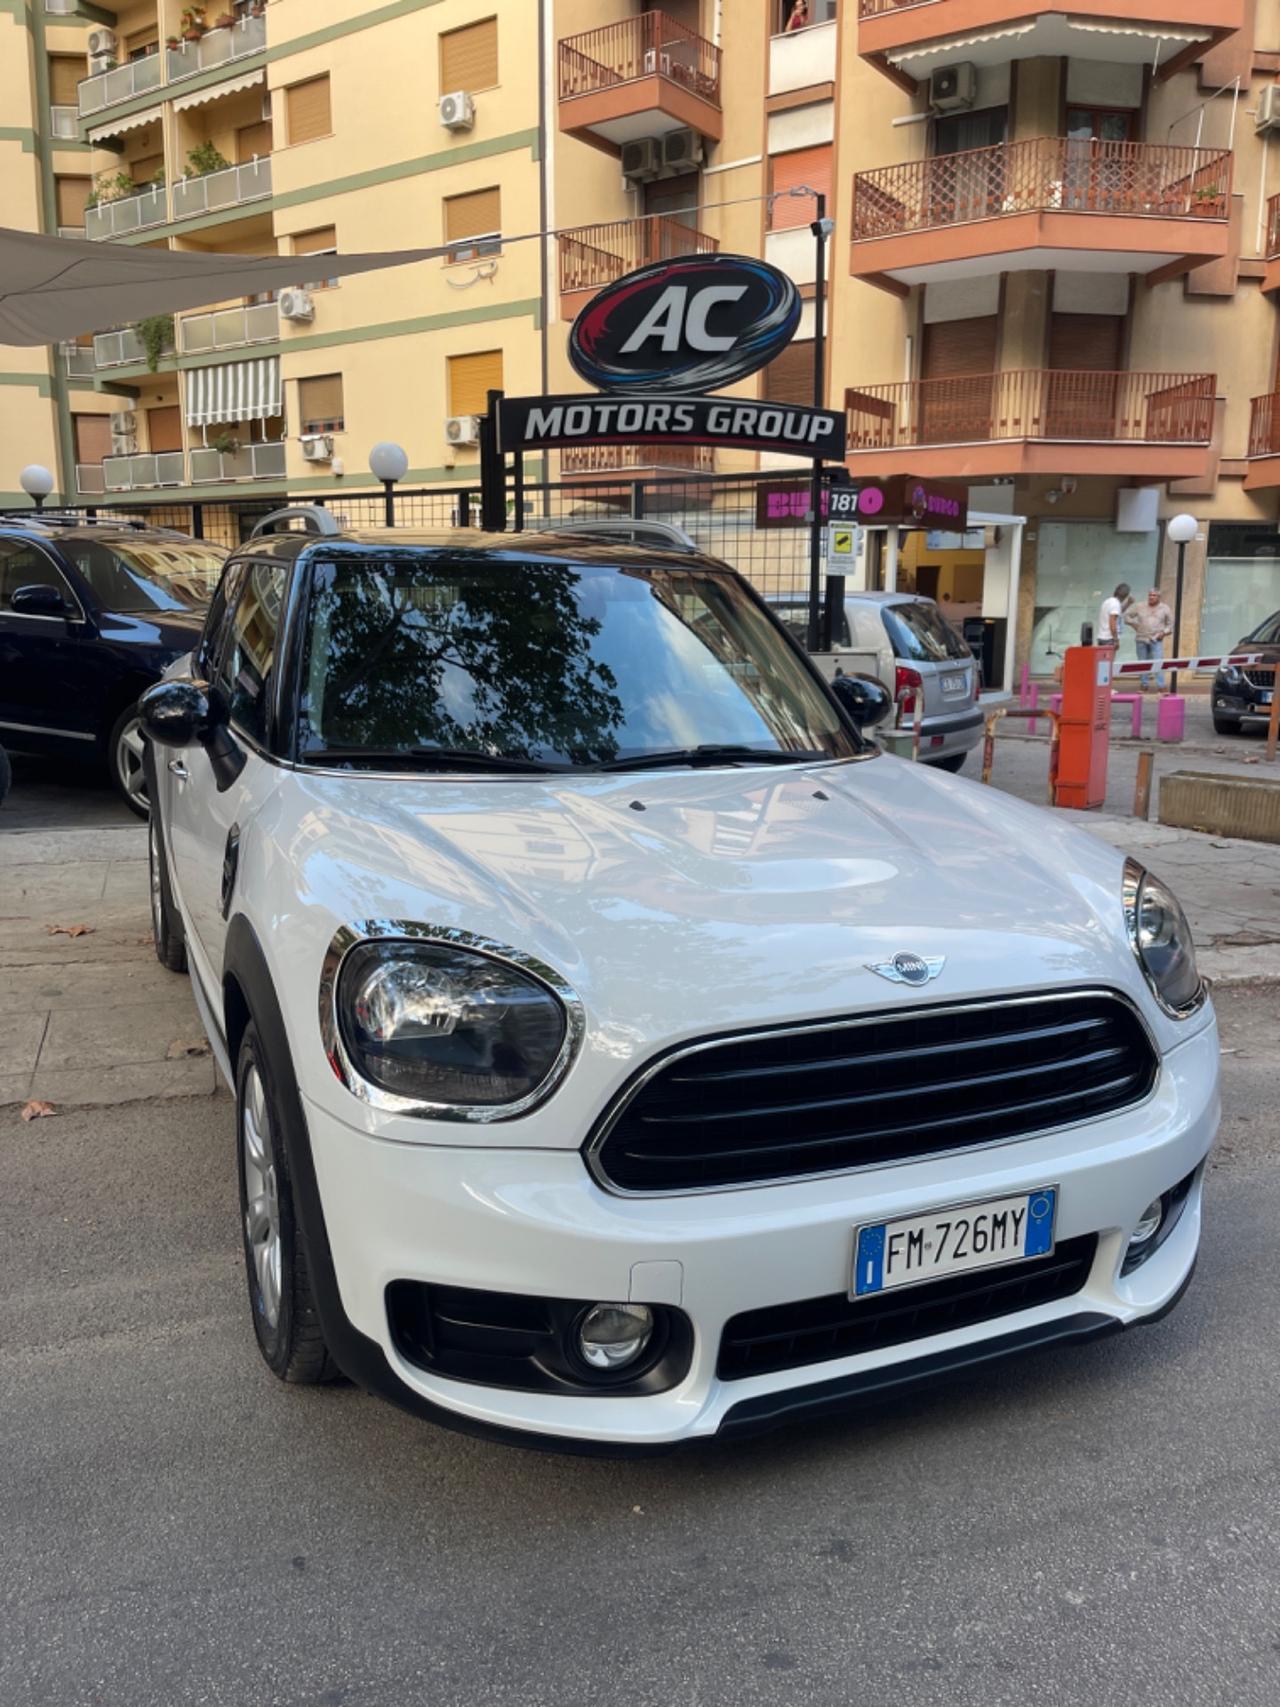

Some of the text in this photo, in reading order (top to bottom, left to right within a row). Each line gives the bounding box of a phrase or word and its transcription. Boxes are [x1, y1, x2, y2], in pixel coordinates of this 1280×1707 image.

[619, 286, 749, 353] AC
[524, 404, 835, 443] MOTORS GROUP
[767, 486, 884, 518] BUO
[831, 493, 858, 512] 181
